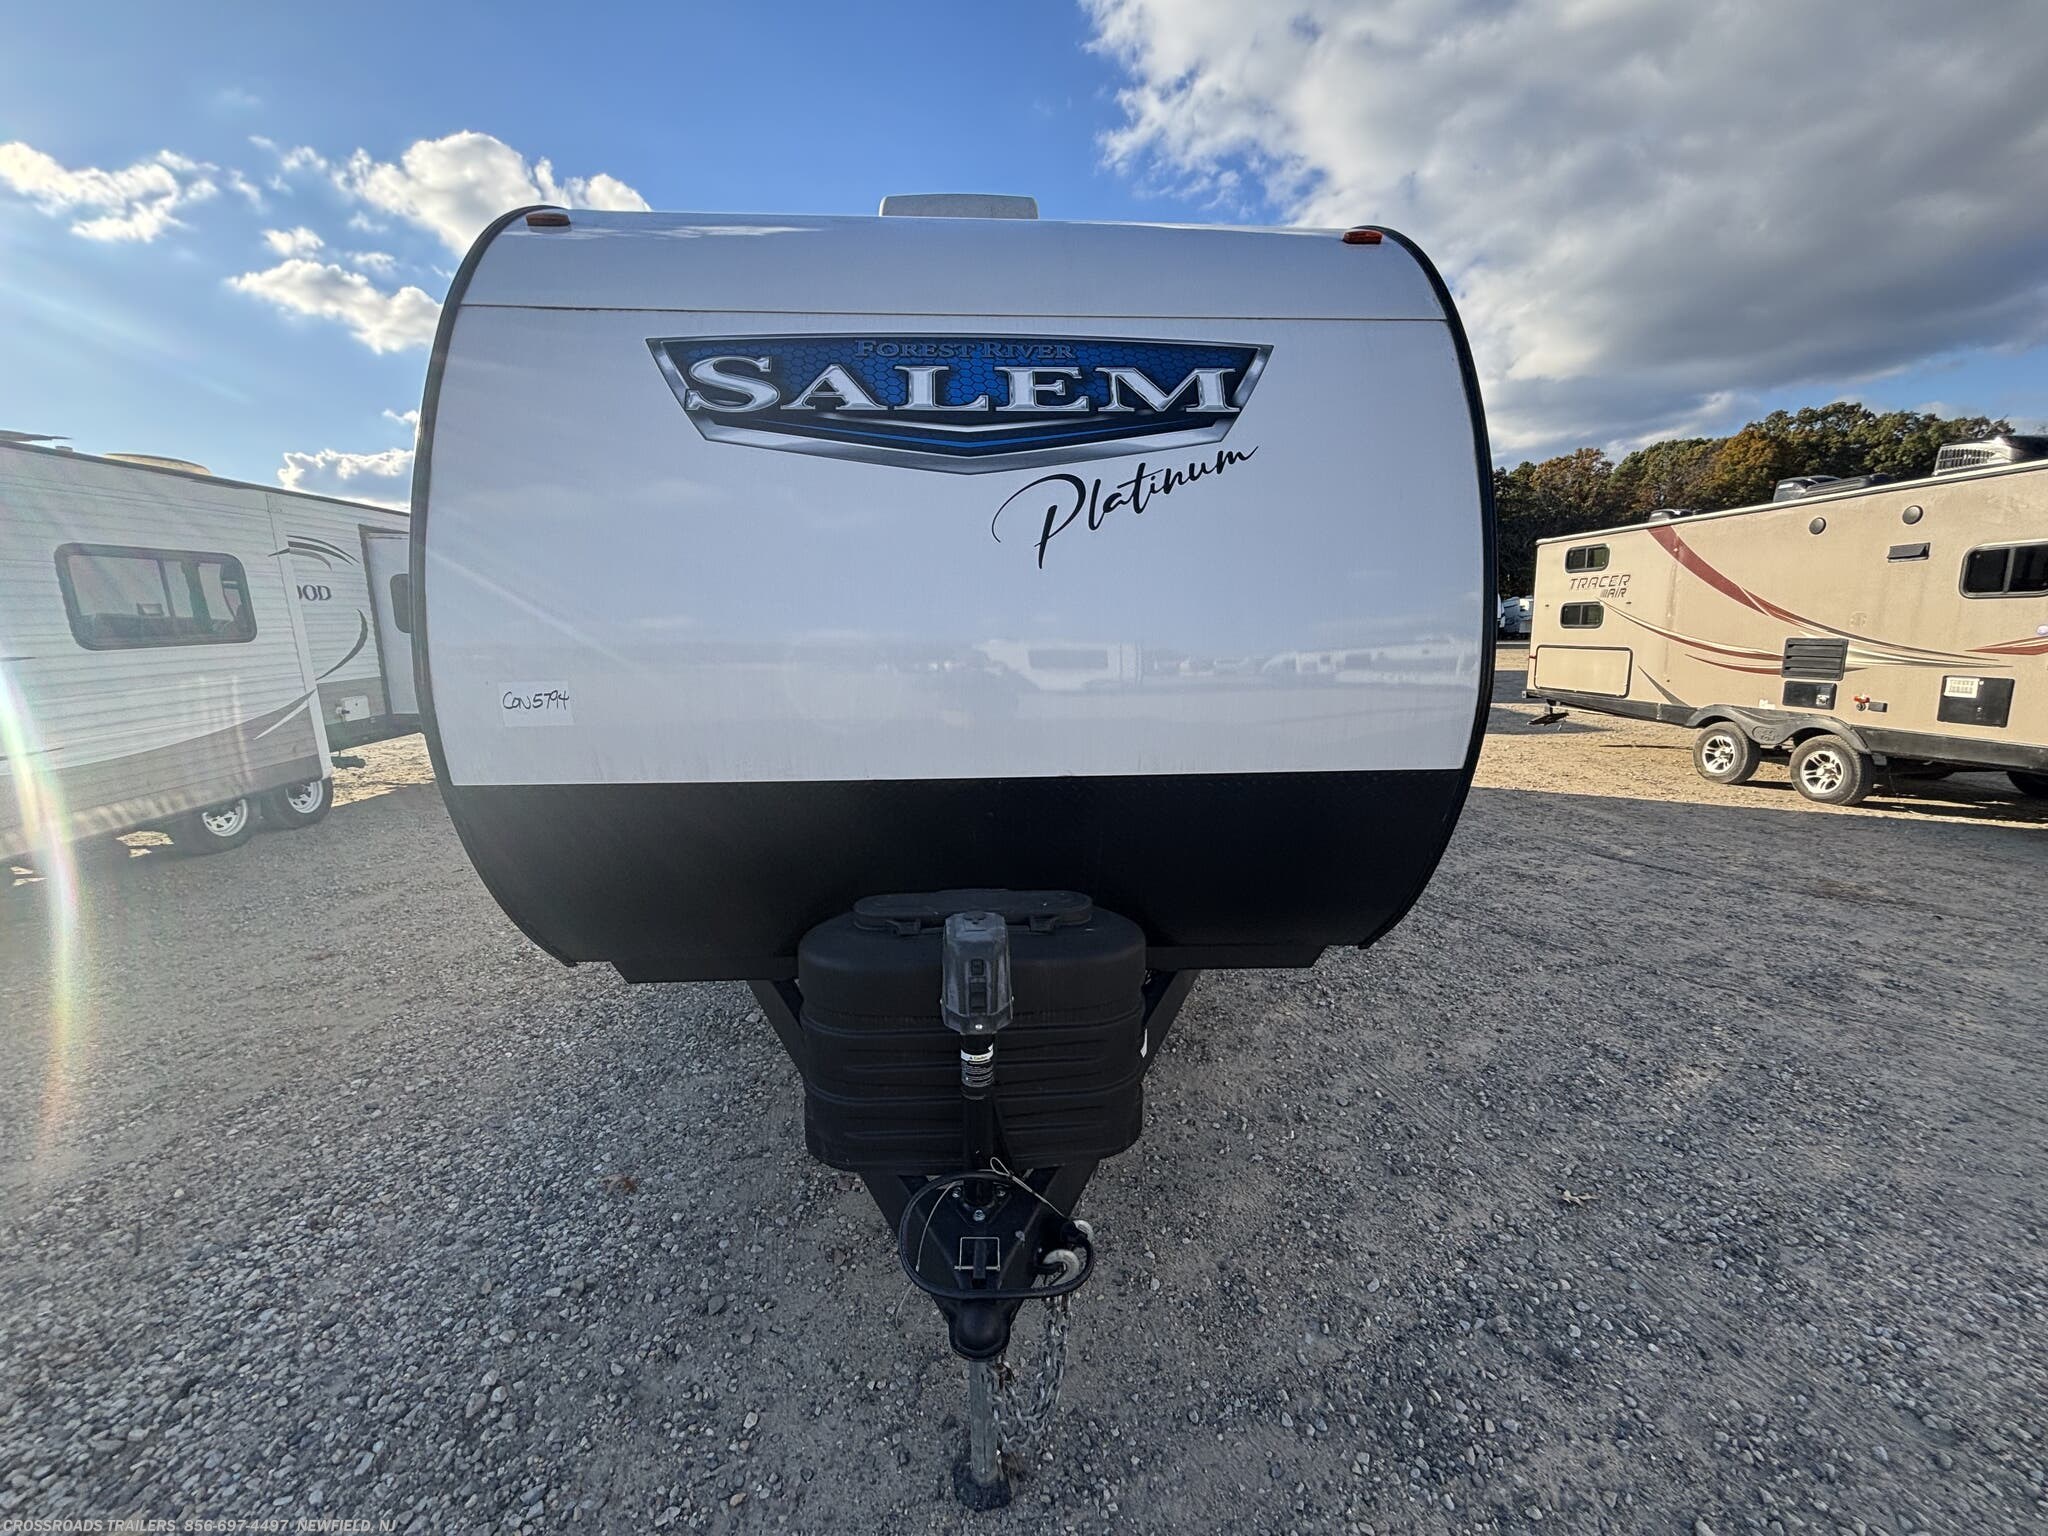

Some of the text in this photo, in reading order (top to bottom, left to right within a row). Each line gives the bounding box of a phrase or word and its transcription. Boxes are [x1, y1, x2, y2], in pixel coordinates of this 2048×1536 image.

[685, 356, 1242, 413] SALEM
[991, 445, 1259, 570] Platinum
[1570, 574, 1631, 590] TRACER
